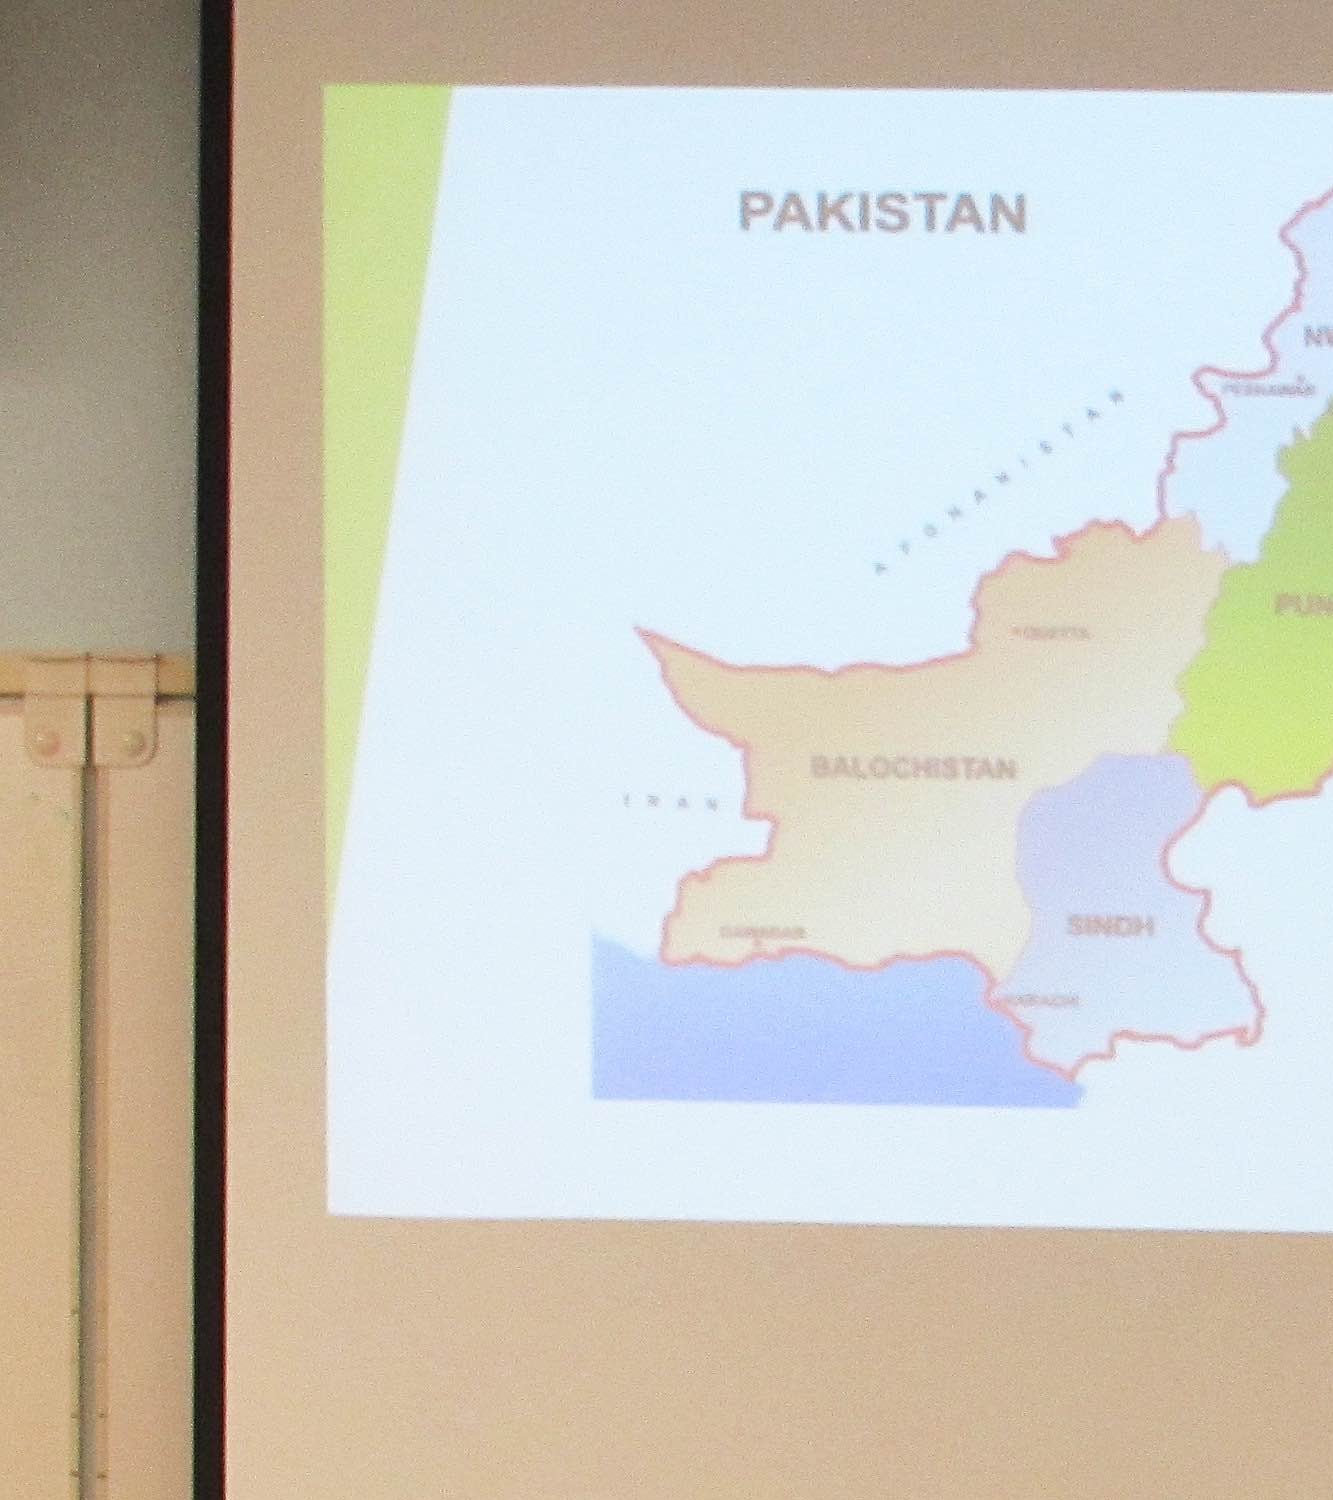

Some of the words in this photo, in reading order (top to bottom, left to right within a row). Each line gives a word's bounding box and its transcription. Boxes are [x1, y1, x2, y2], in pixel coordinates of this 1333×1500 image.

[739, 190, 1026, 233] PAKISTAN
[811, 755, 1017, 780] BALOCHISTAN
[622, 793, 719, 811] IRAN
[1067, 915, 1155, 937] SINDH
